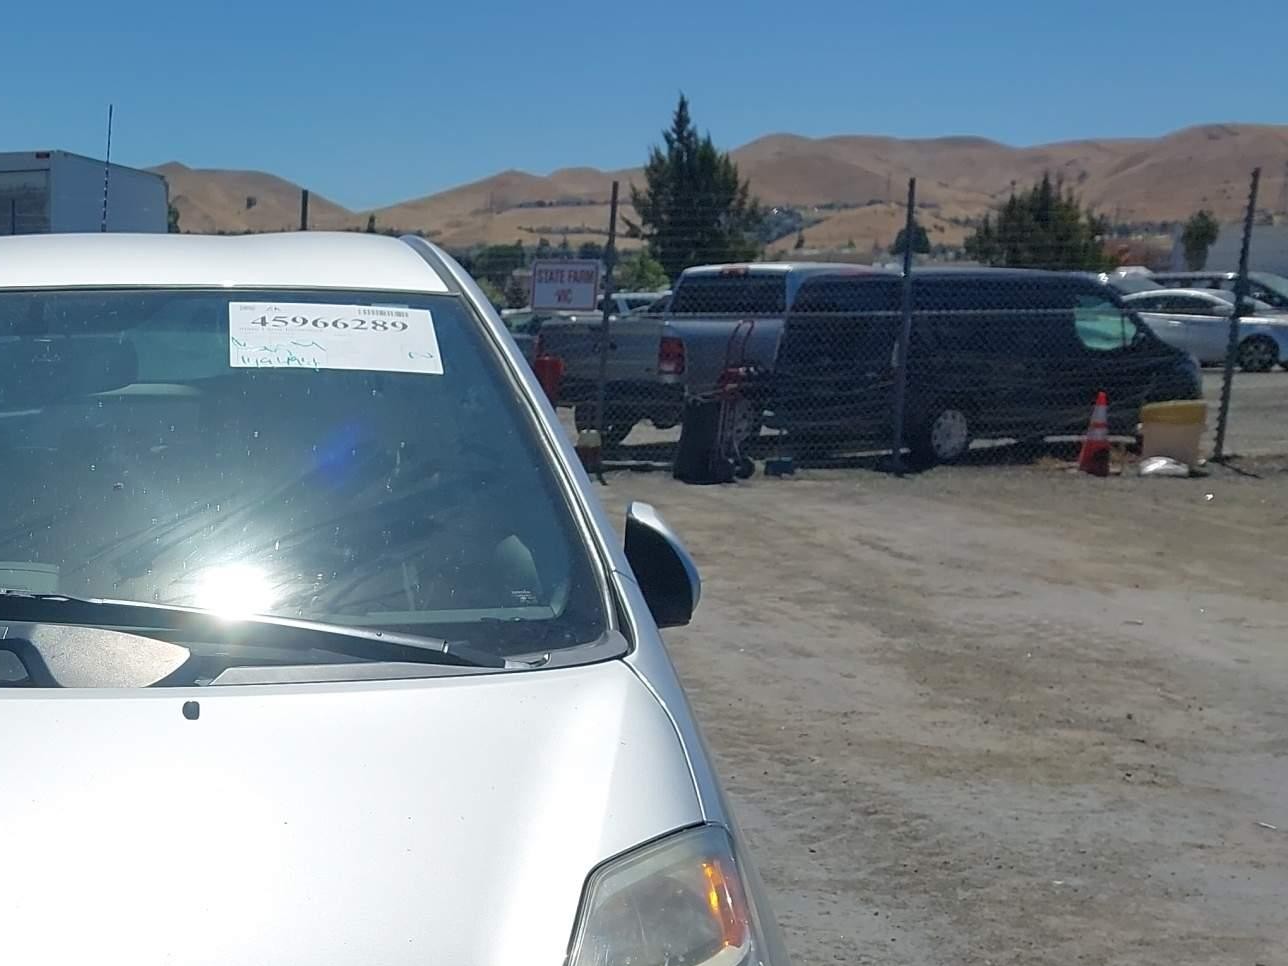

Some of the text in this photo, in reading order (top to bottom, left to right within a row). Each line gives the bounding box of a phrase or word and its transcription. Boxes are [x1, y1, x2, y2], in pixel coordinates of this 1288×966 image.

[537, 269, 594, 284] STATE FARM
[250, 315, 409, 333] 45966289
